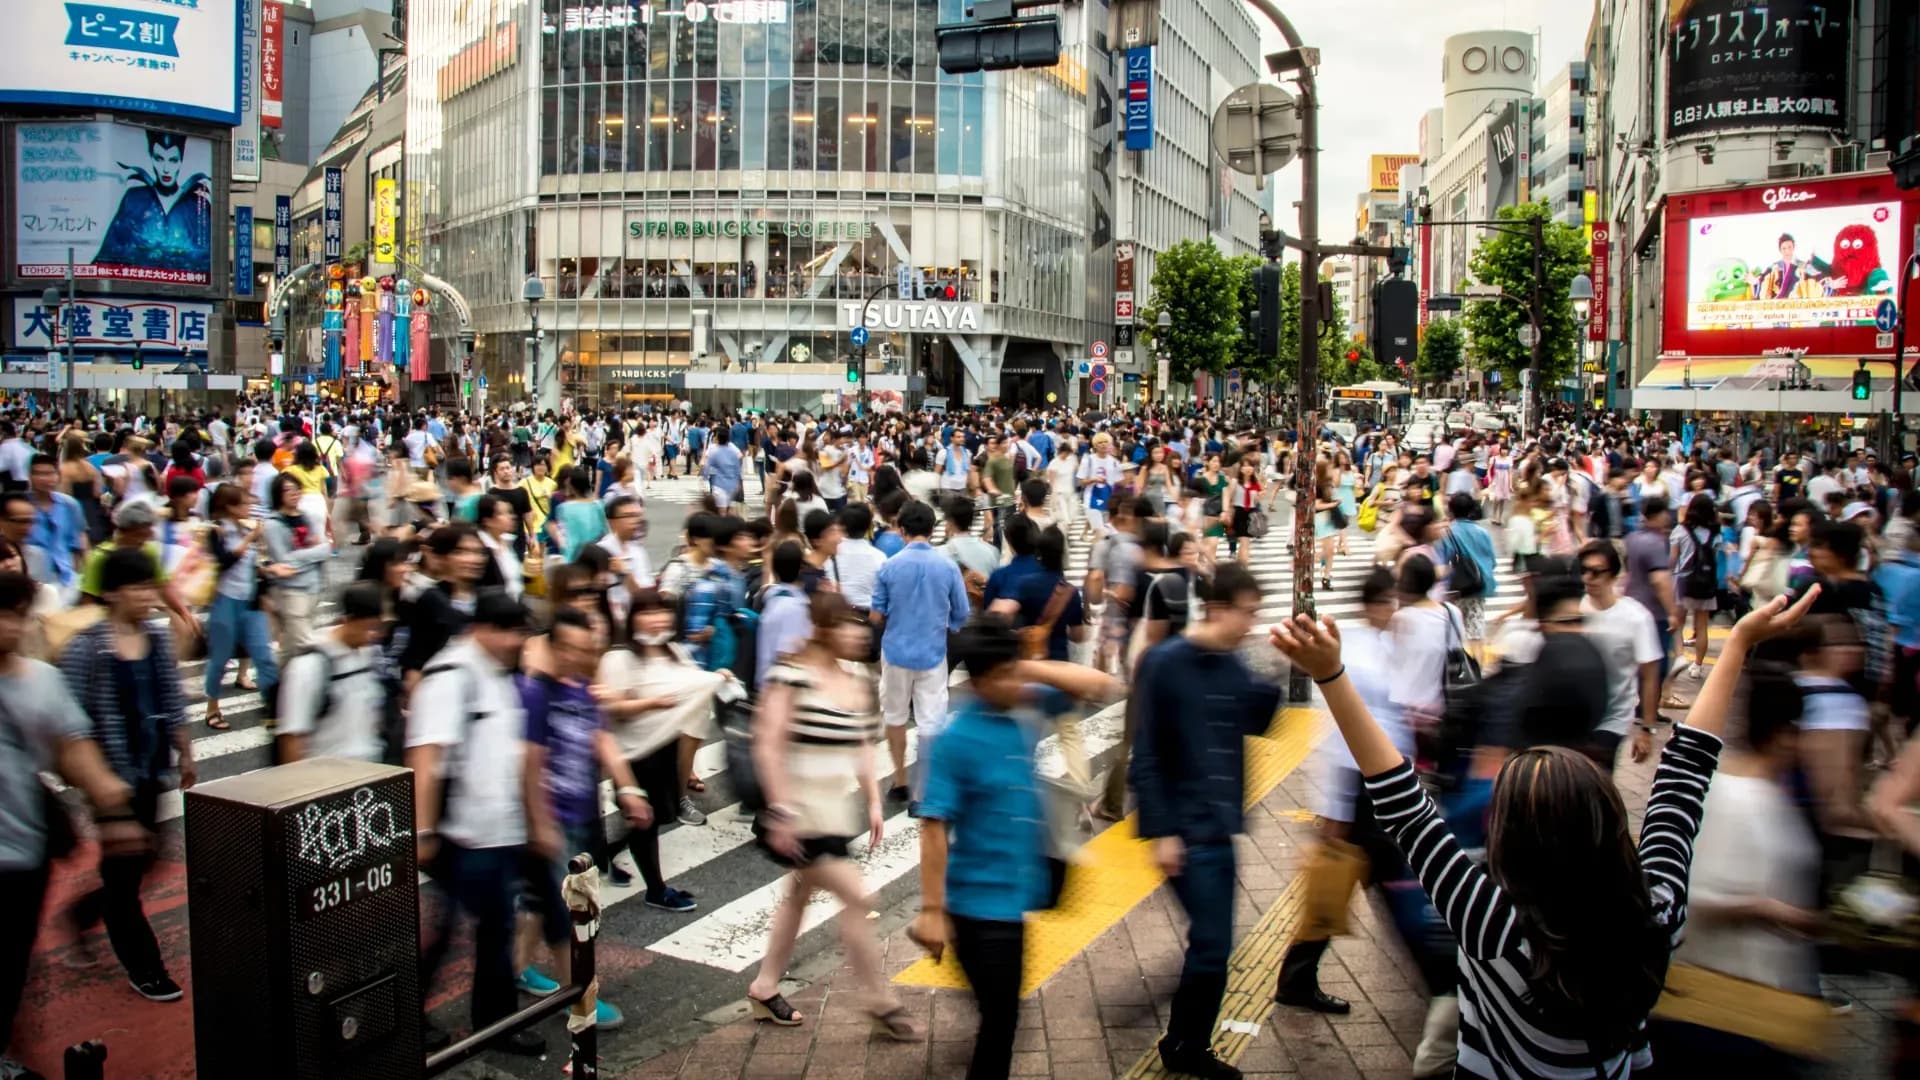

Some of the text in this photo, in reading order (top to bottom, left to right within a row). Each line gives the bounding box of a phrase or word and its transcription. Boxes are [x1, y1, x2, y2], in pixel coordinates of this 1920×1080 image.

[81, 13, 165, 45] ピース割
[1711, 47, 1793, 64] ロストエイジ
[1128, 55, 1149, 132] SEIBU
[1492, 122, 1516, 164] ZAR
[326, 172, 340, 256] 洋服の青山
[1763, 187, 1817, 210] Glico
[21, 213, 97, 233] マレフィセント
[629, 220, 873, 239] STARBUCKS COFFEE
[23, 306, 206, 341] 大盛堂書店
[843, 302, 978, 330] TSUTAYA
[313, 862, 393, 912] 331-06
